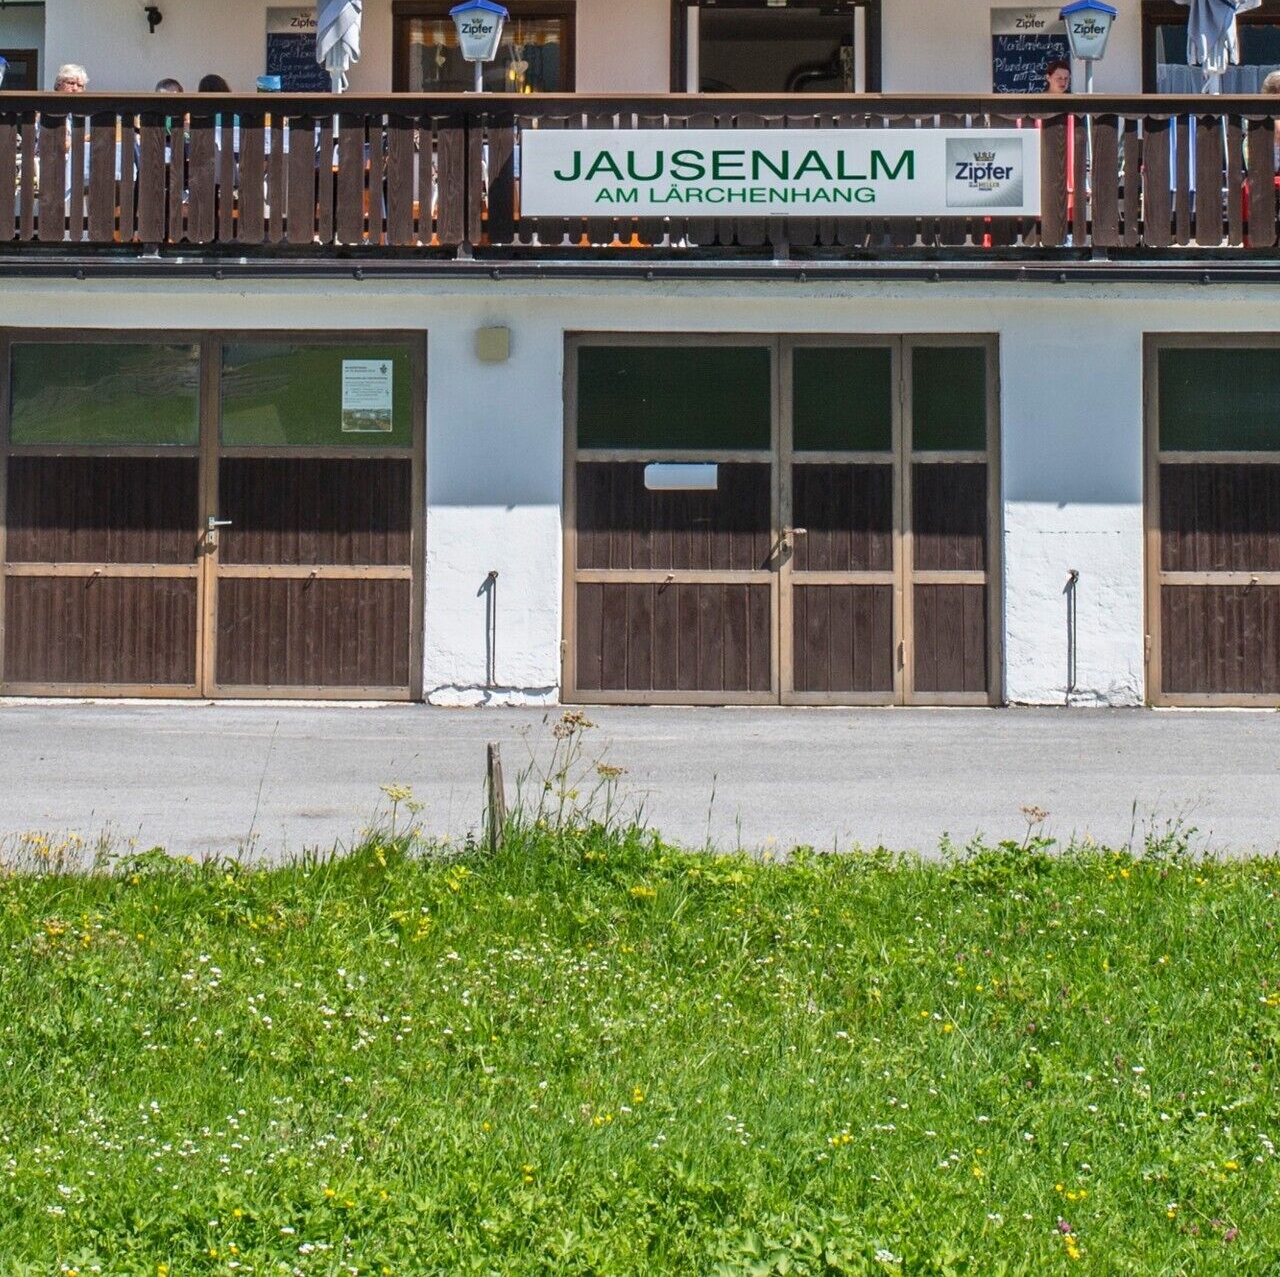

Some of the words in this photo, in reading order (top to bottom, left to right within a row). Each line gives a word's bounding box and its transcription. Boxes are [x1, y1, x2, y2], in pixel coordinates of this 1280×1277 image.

[461, 23, 493, 35] Zipfer
[1015, 18, 1046, 30] Zipfer
[1073, 24, 1105, 36] Zipfer
[554, 149, 915, 182] JAUSENALM
[955, 162, 1014, 184] Zipfer
[595, 187, 639, 203] AM
[649, 184, 877, 204] LÄRCHENHANG
